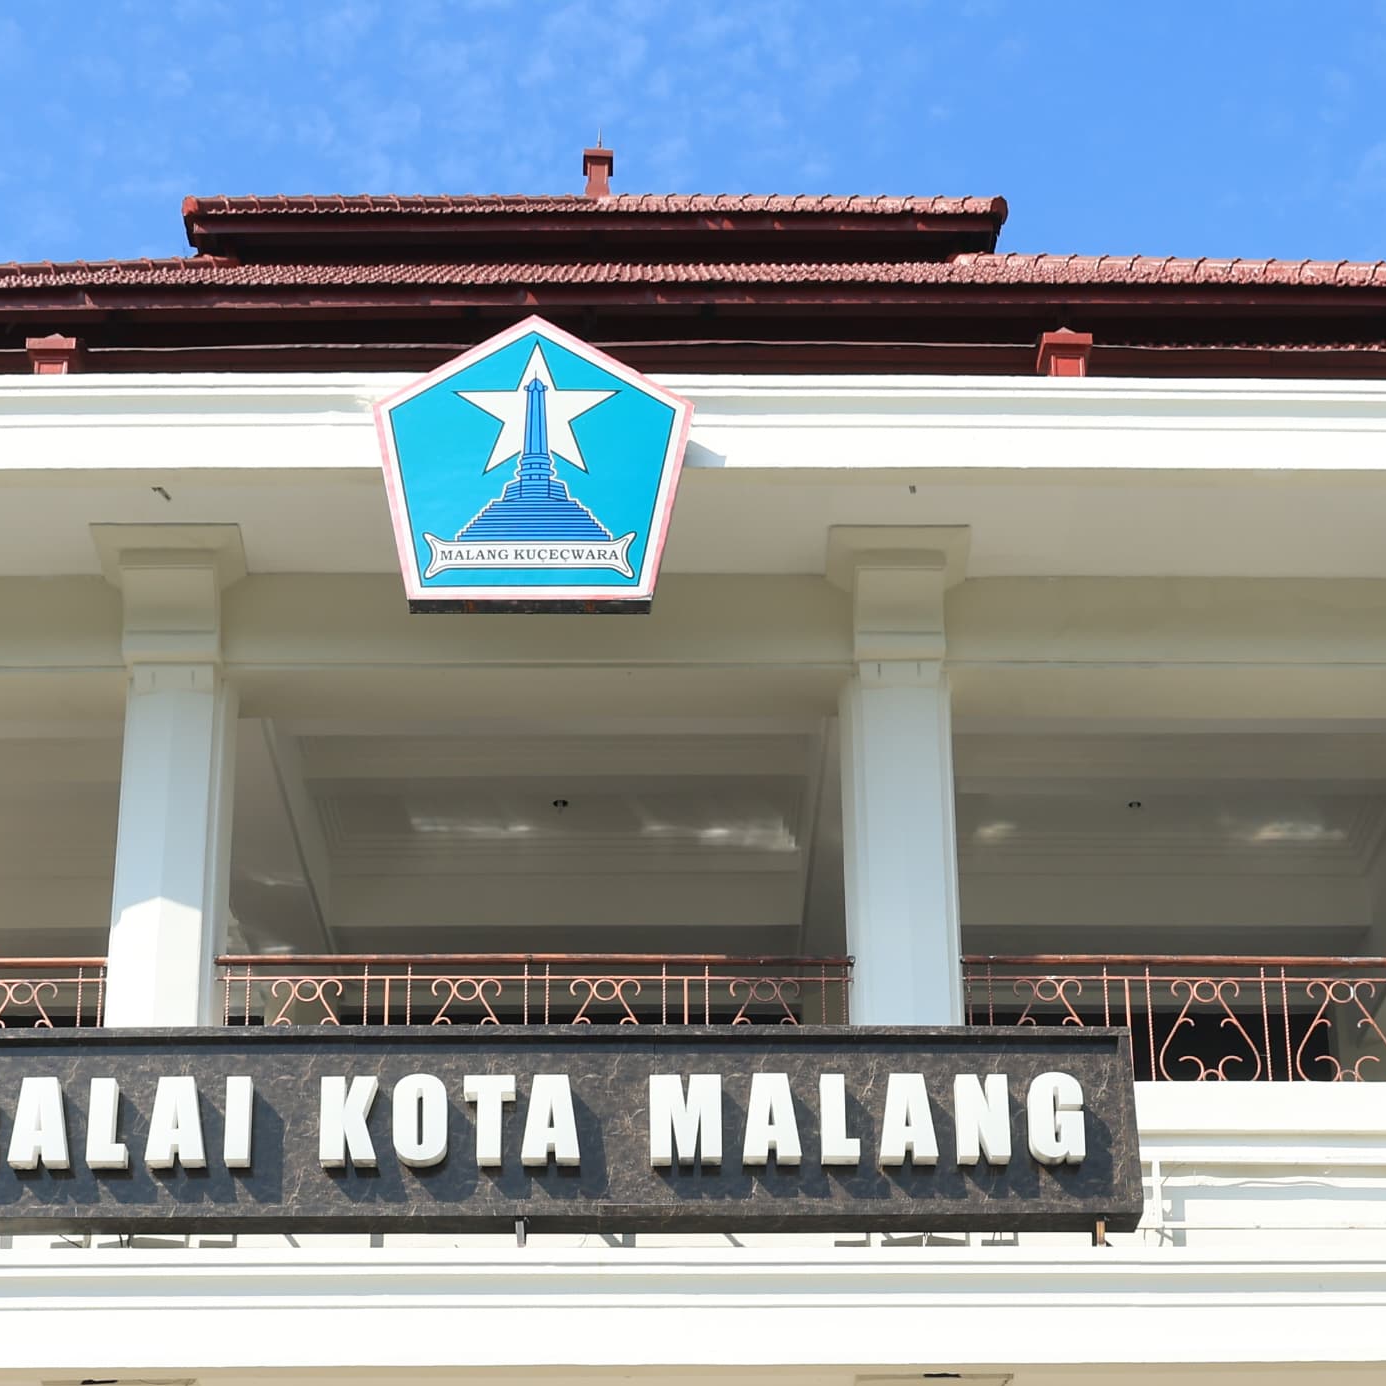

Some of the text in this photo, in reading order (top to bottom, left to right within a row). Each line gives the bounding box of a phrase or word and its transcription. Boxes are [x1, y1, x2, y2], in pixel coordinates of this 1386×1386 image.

[441, 550, 509, 561] MALANG
[319, 1073, 581, 1169] KOTA
[649, 1071, 1087, 1169] MALANG
